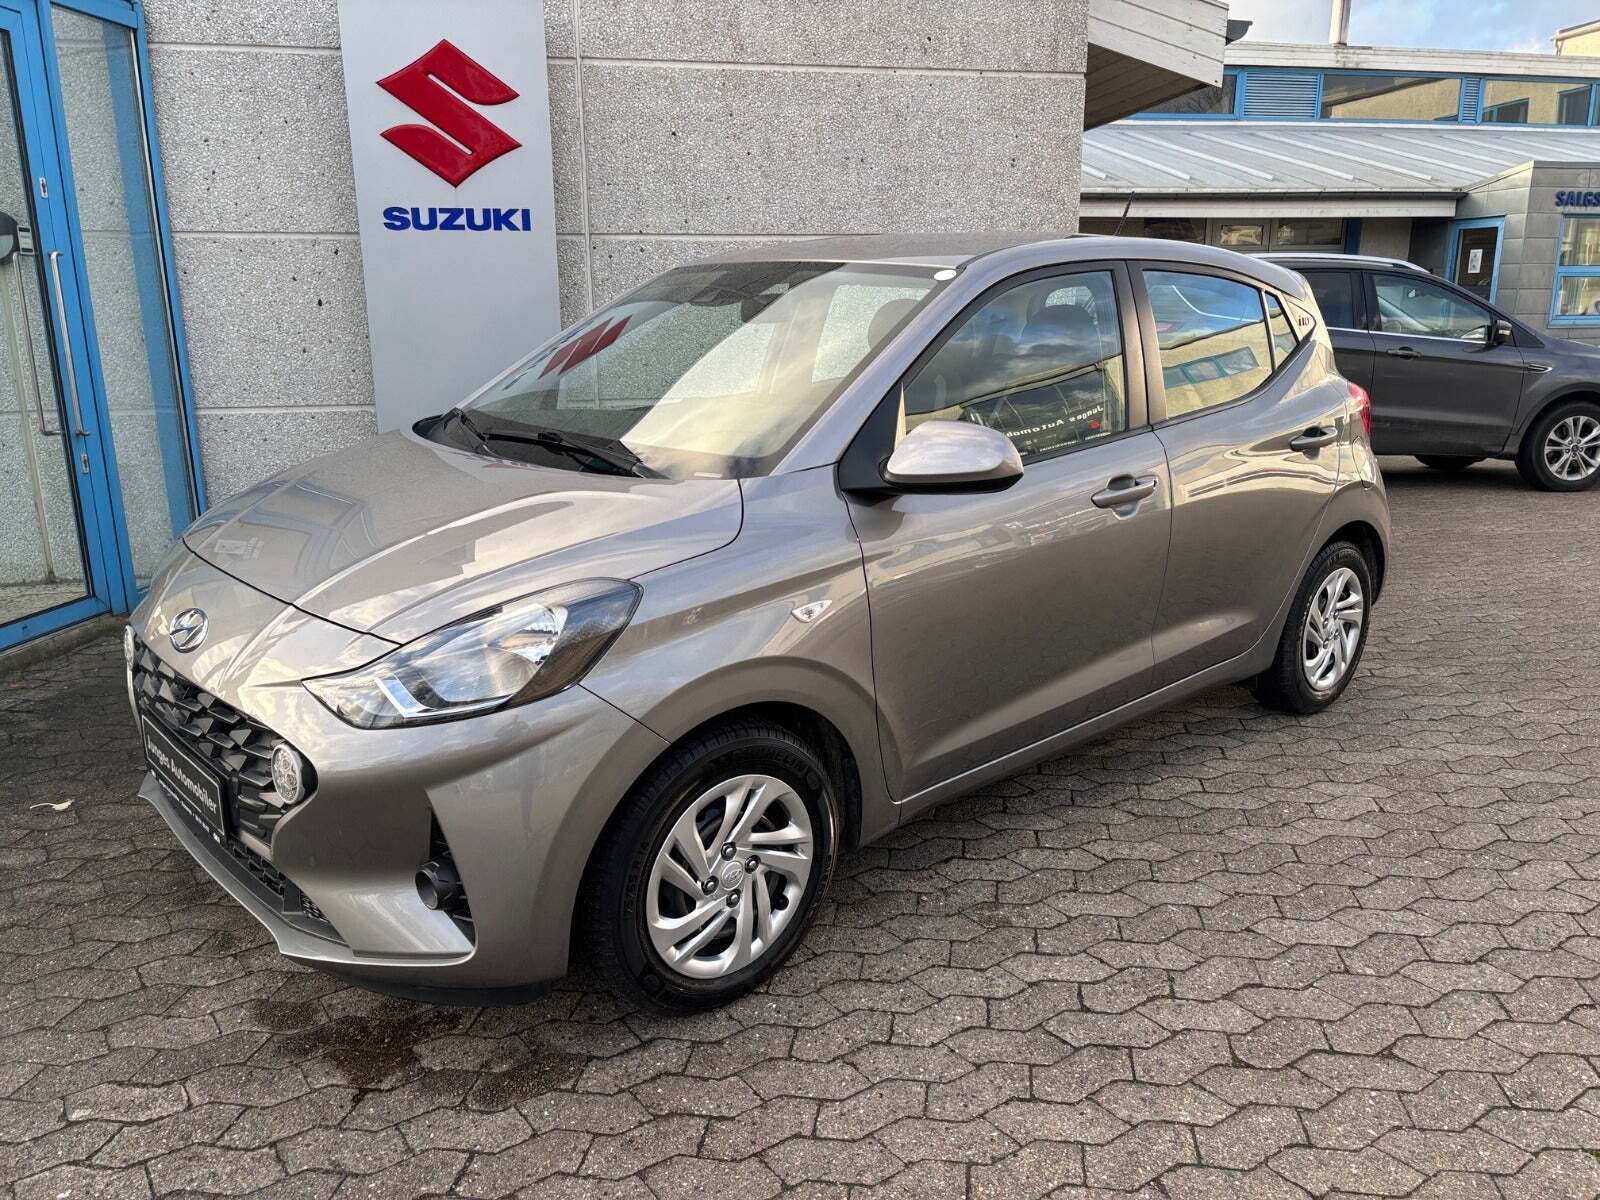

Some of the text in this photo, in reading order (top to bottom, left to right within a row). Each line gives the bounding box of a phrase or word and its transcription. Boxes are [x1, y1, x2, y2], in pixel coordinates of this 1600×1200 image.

[383, 206, 531, 231] SUZUKI
[147, 735, 170, 769] Junges
[171, 758, 217, 814] Automobiler
